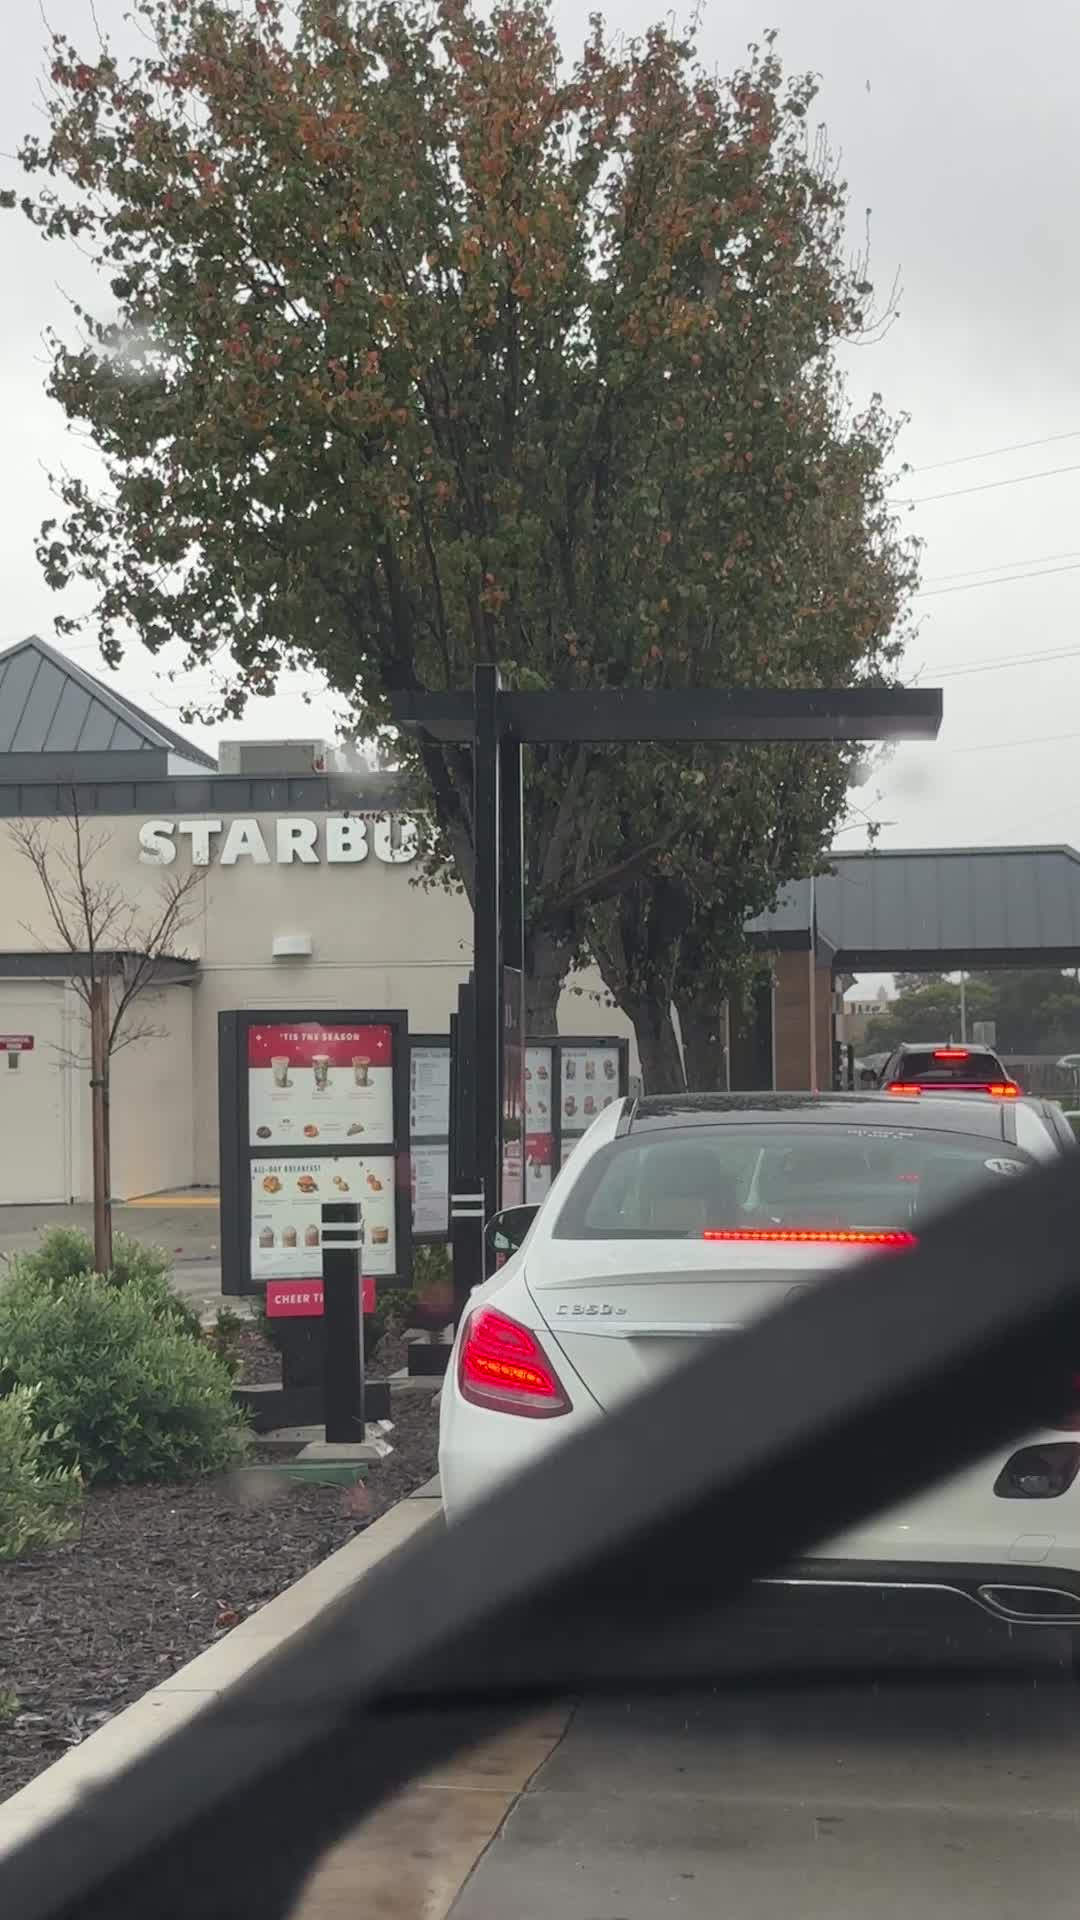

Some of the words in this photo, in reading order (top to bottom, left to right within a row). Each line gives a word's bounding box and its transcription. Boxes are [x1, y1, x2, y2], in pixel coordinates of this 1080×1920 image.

[138, 818, 430, 865] STARBU
[302, 1032, 319, 1041] THE
[322, 1032, 361, 1041] SEASON
[274, 1294, 310, 1305] CHEER
